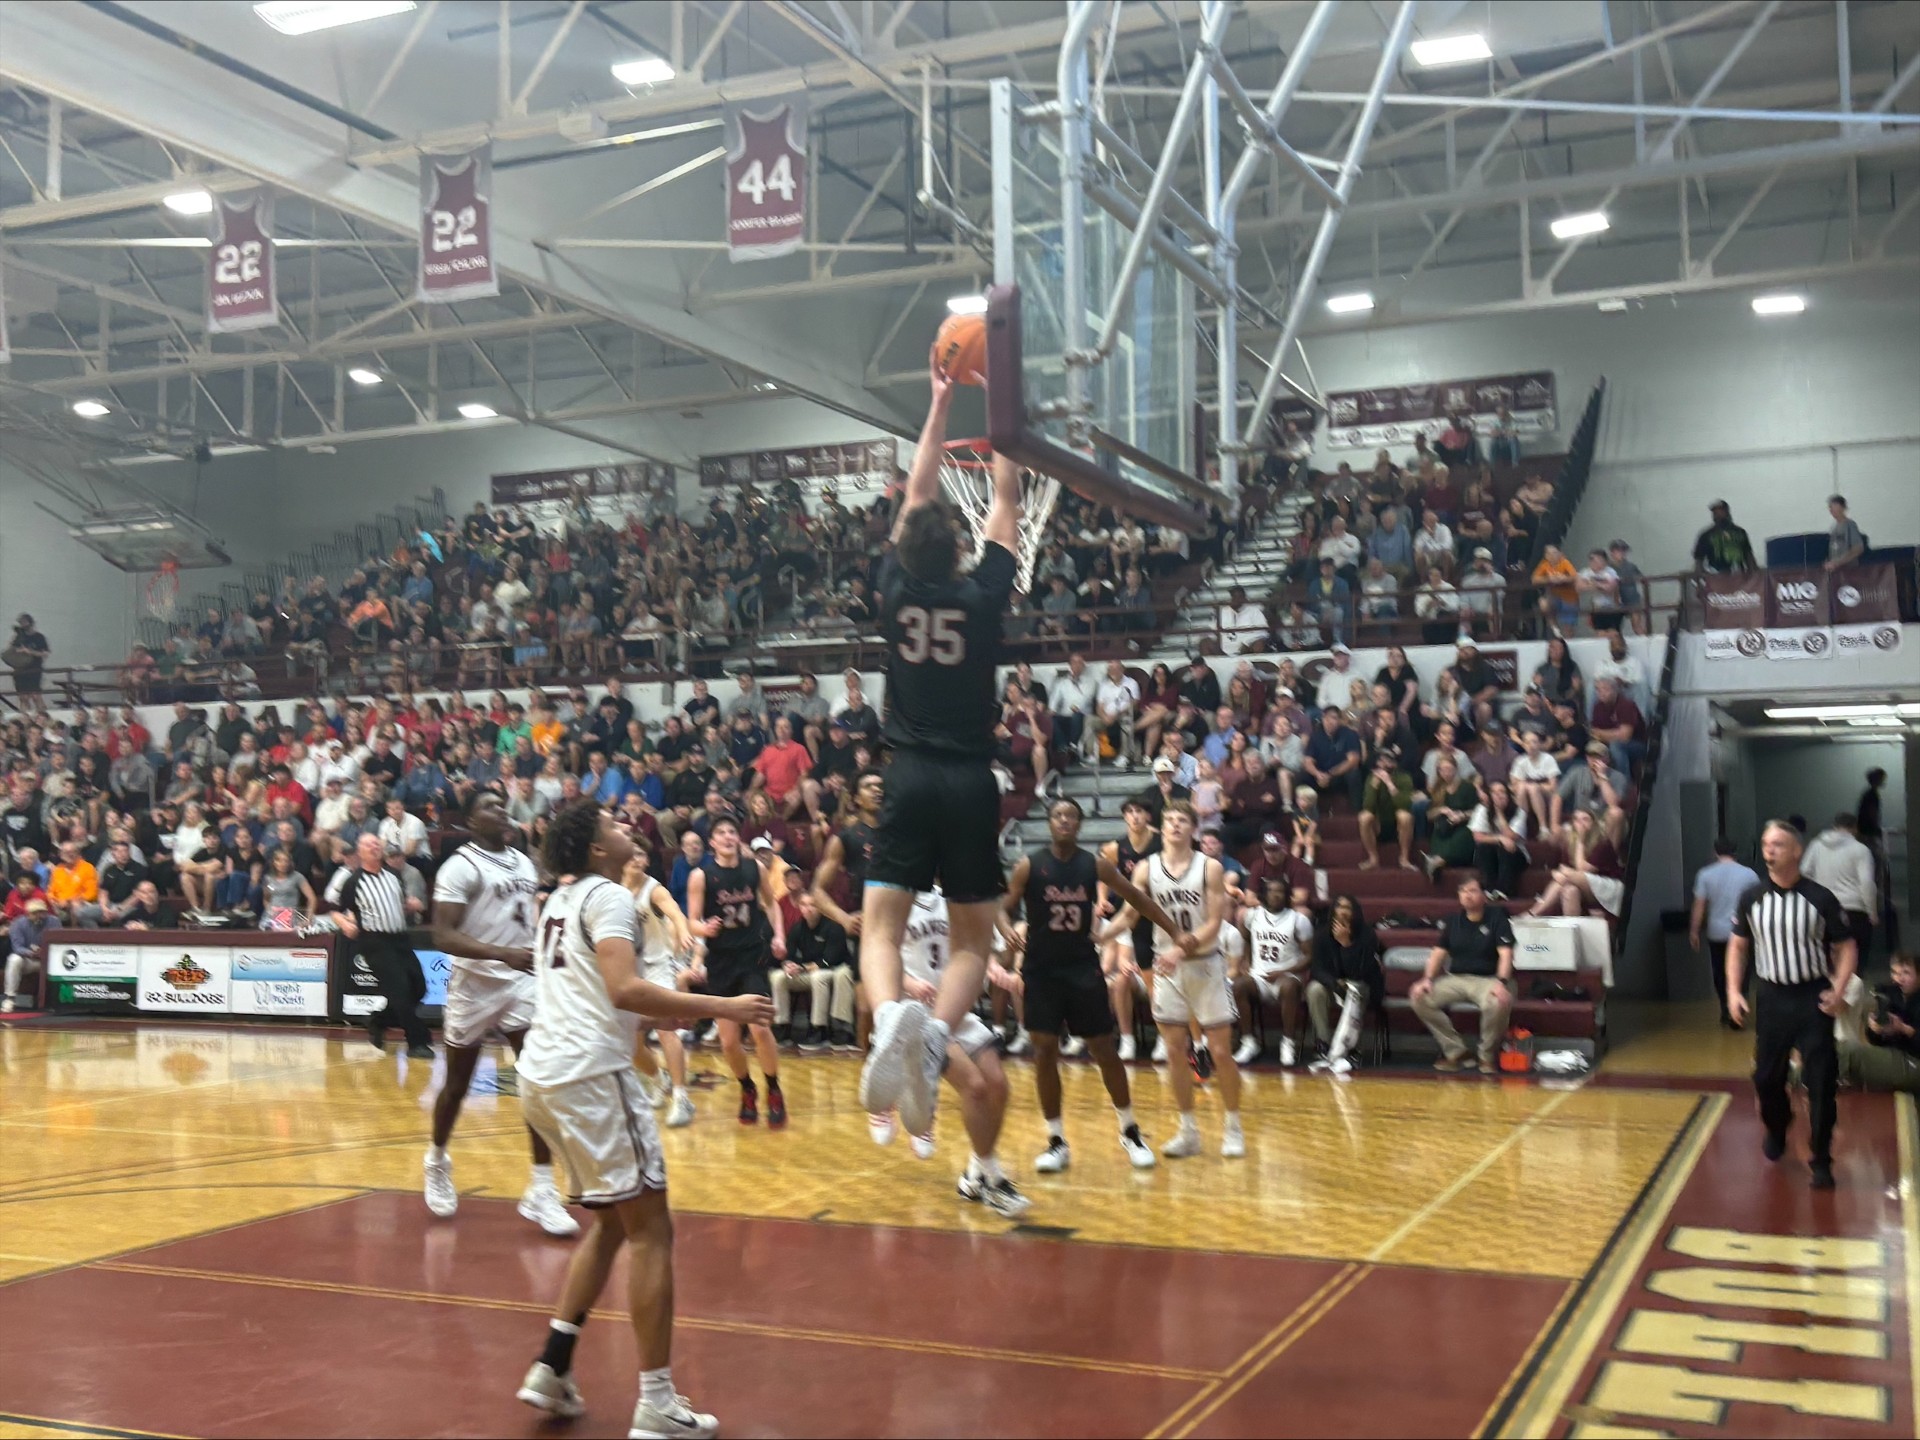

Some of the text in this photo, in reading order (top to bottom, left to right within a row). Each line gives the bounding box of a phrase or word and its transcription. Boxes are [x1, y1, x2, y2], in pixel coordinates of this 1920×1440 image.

[737, 154, 797, 204] 44
[432, 206, 478, 252] 22
[215, 241, 262, 284] 22
[896, 605, 966, 665] 35
[723, 903, 750, 928] 24
[1048, 904, 1081, 931] 23
